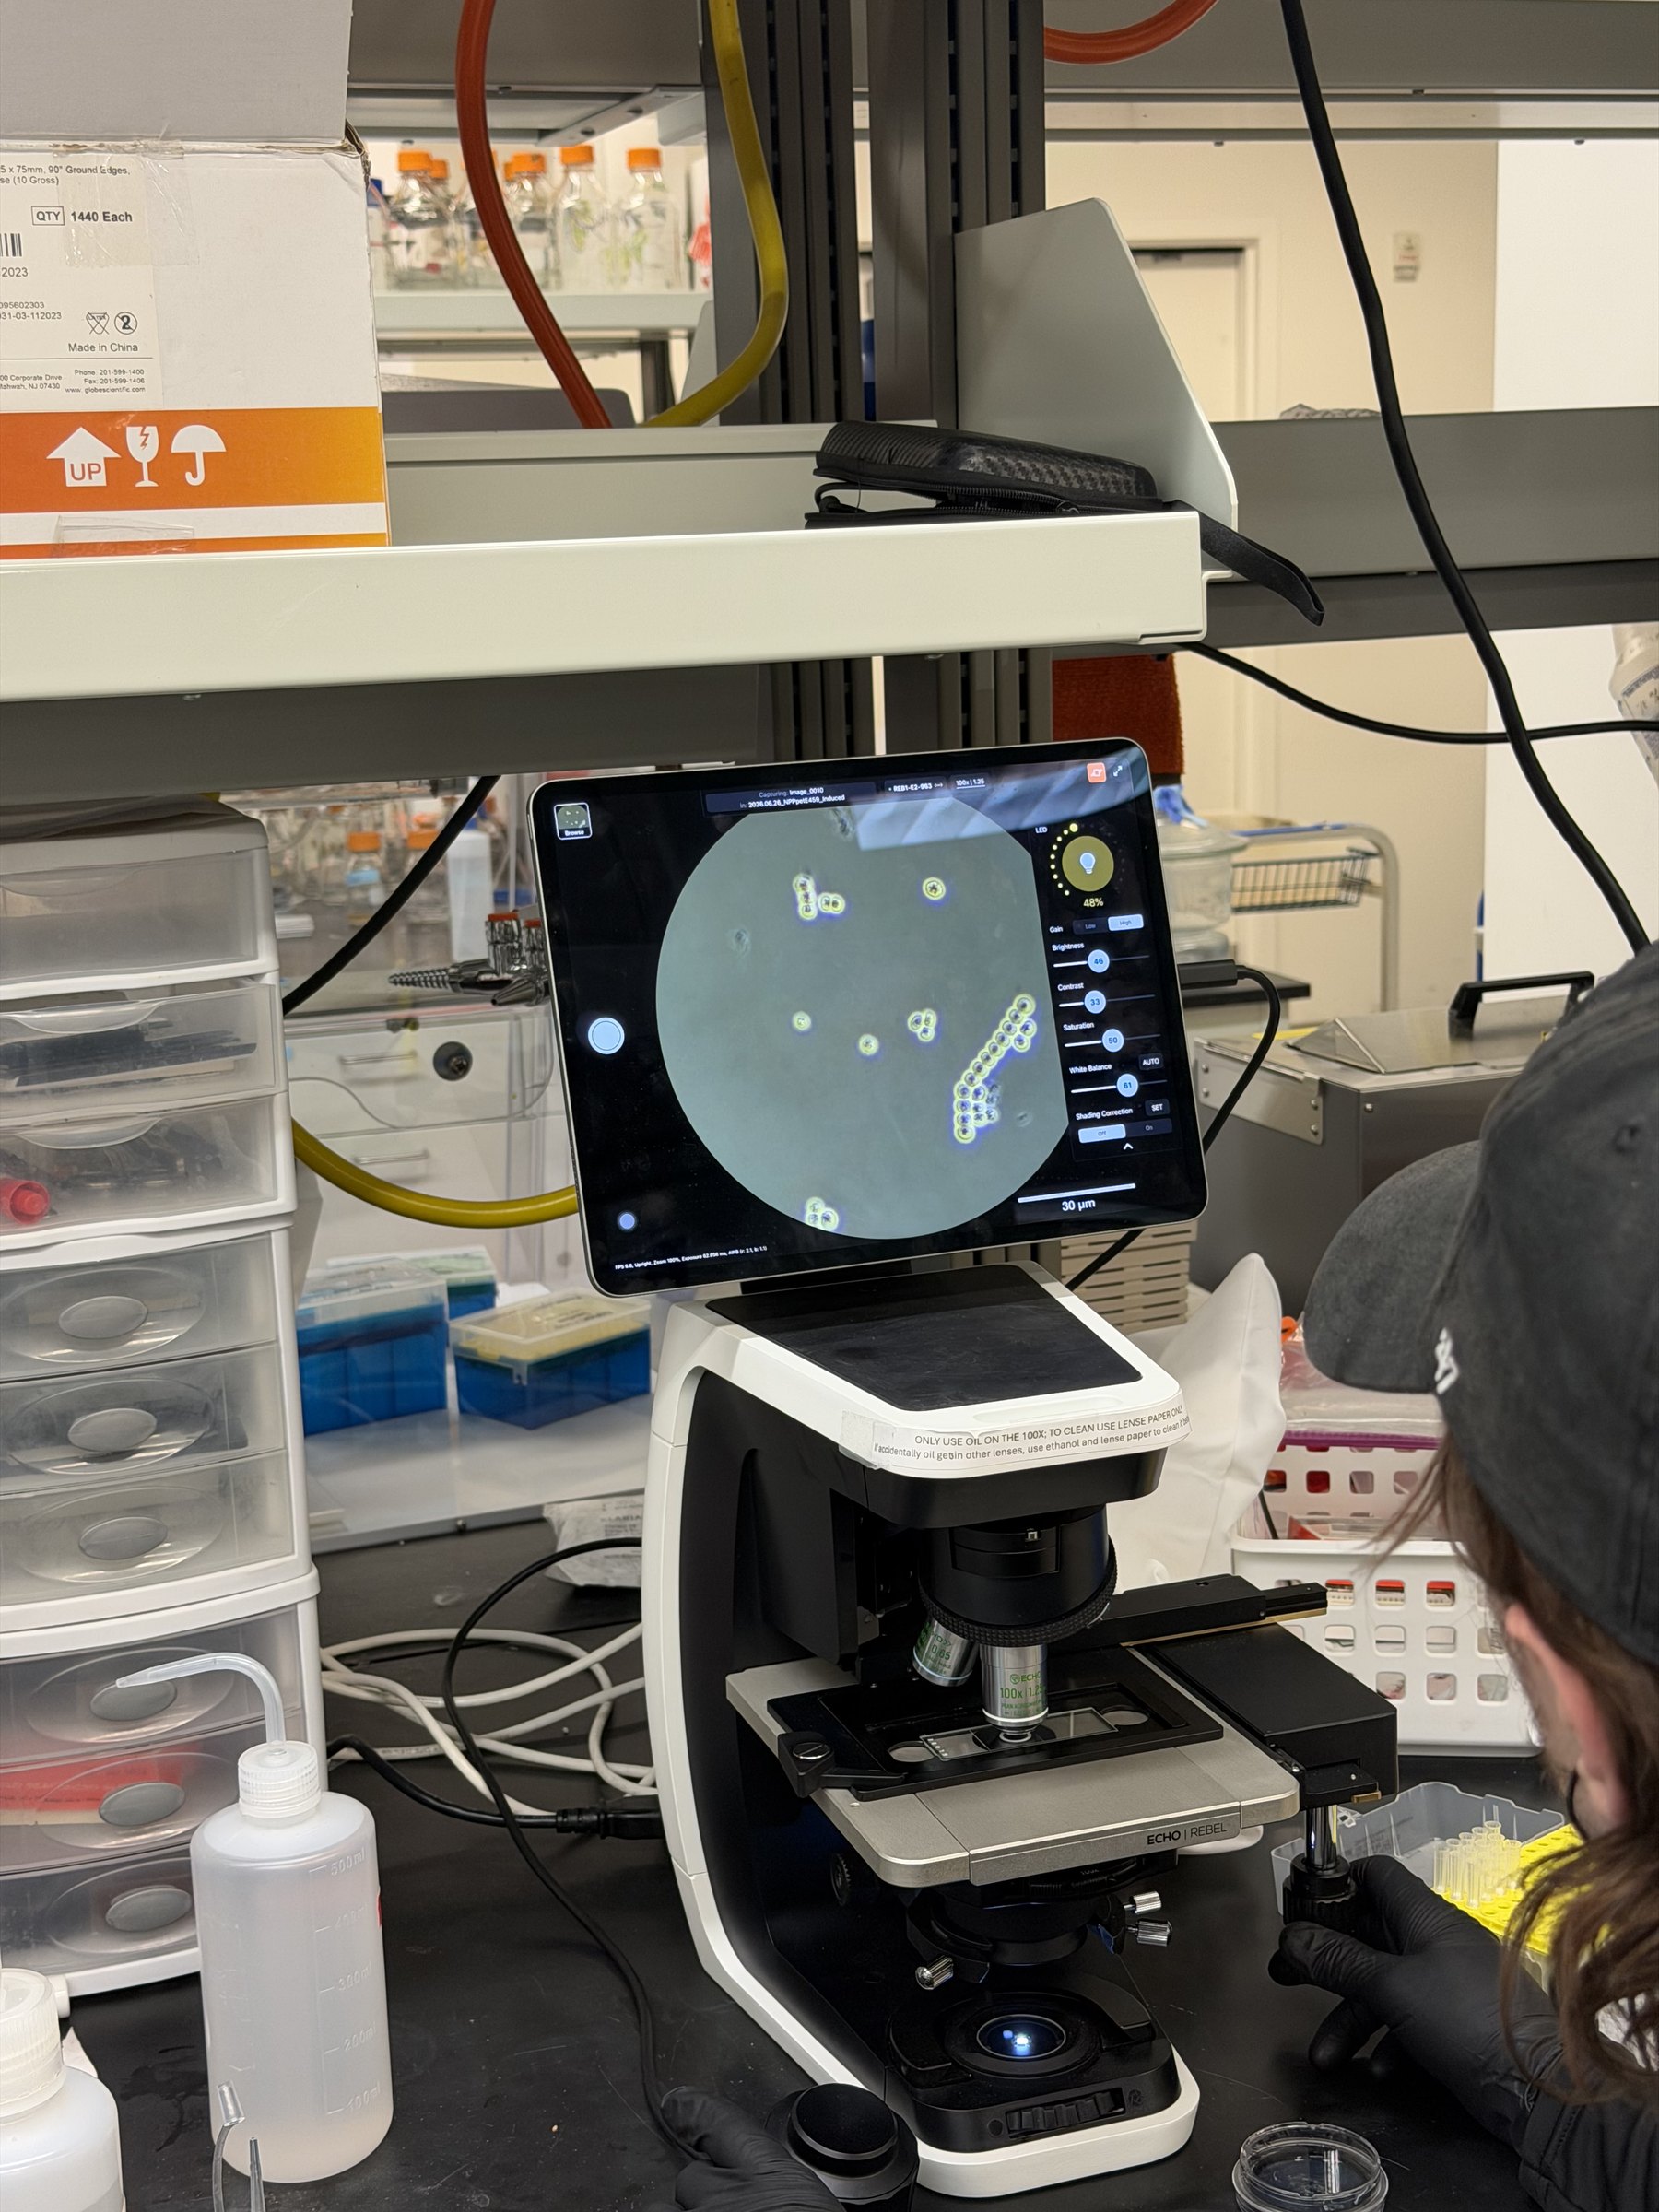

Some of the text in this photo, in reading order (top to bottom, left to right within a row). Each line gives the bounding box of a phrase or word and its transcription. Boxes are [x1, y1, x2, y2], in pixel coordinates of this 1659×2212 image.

[65, 165, 98, 174] Ground
[100, 166, 130, 176] Edges,
[13, 175, 28, 186] (10
[29, 175, 60, 186] Gross)
[36, 211, 61, 222] QTY
[71, 211, 133, 222] 1440 Each
[68, 343, 138, 352] Made in China
[70, 463, 102, 481] UP
[759, 787, 824, 798] Capturing: Image_0010
[1035, 826, 1048, 834] LED
[1083, 898, 1104, 908] 48%
[1049, 925, 1064, 934] Gain
[1052, 942, 1085, 952] Brightness
[1057, 982, 1085, 991] Contrast
[1063, 1021, 1095, 1030] Saturation
[1142, 1057, 1160, 1066] AUTO
[1069, 1063, 1112, 1074] White Balance
[1151, 1103, 1164, 1112] SET
[1076, 1107, 1134, 1121] Shading Correction
[1062, 1202, 1076, 1211] 30
[914, 1435, 941, 1446] ONLY
[943, 1437, 963, 1446] USE
[965, 1437, 982, 1446] OIL
[984, 1435, 999, 1444] ON
[1002, 1432, 1019, 1442] THE
[1022, 1430, 1047, 1441] 100X;
[1049, 1428, 1062, 1437] TO
[1064, 1424, 1095, 1436] CLEAN
[1097, 1422, 1116, 1431] USE
[1118, 1418, 1147, 1430] LENSE
[1147, 1410, 1171, 1424] PAPER
[878, 1444, 922, 1460] accidentally
[923, 1450, 935, 1459] oil
[965, 1448, 991, 1459] other
[993, 1446, 1025, 1457] lenses,
[1028, 1445, 1044, 1453] use
[1045, 1436, 1080, 1451] ethanol
[1082, 1437, 1099, 1447] and
[1100, 1433, 1124, 1444] lense
[1126, 1430, 1152, 1443] paper
[1153, 1428, 1161, 1436] to
[1162, 1423, 1179, 1433] clean
[1000, 1688, 1023, 1700] 100x
[1147, 1830, 1182, 1845] ECHO
[1190, 1822, 1228, 1839] REBEL
[331, 1846, 366, 1877] 500ml
[344, 2020, 378, 2053] 200ml
